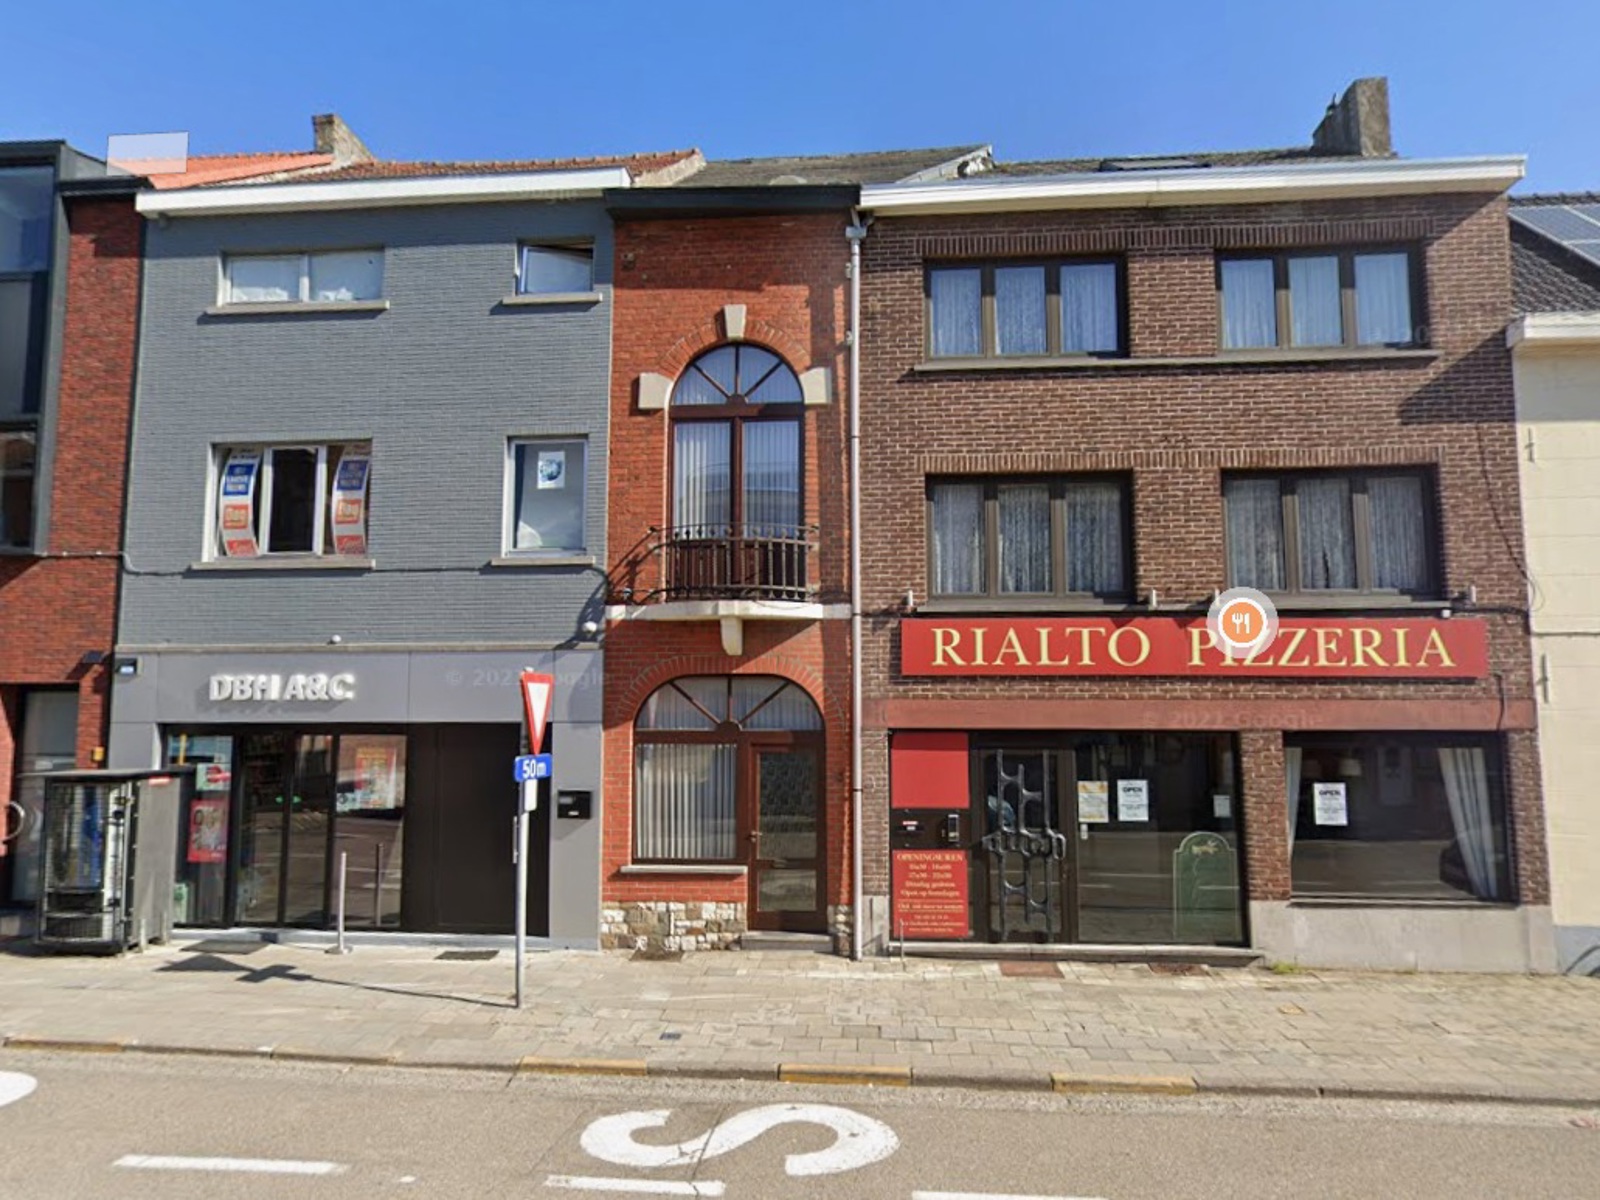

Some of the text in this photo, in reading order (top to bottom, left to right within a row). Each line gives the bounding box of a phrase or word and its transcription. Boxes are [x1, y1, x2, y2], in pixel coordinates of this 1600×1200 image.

[931, 626, 1456, 667] RIALTO PIZZERIA
[283, 673, 355, 700] A&C
[522, 758, 547, 778] 50m
